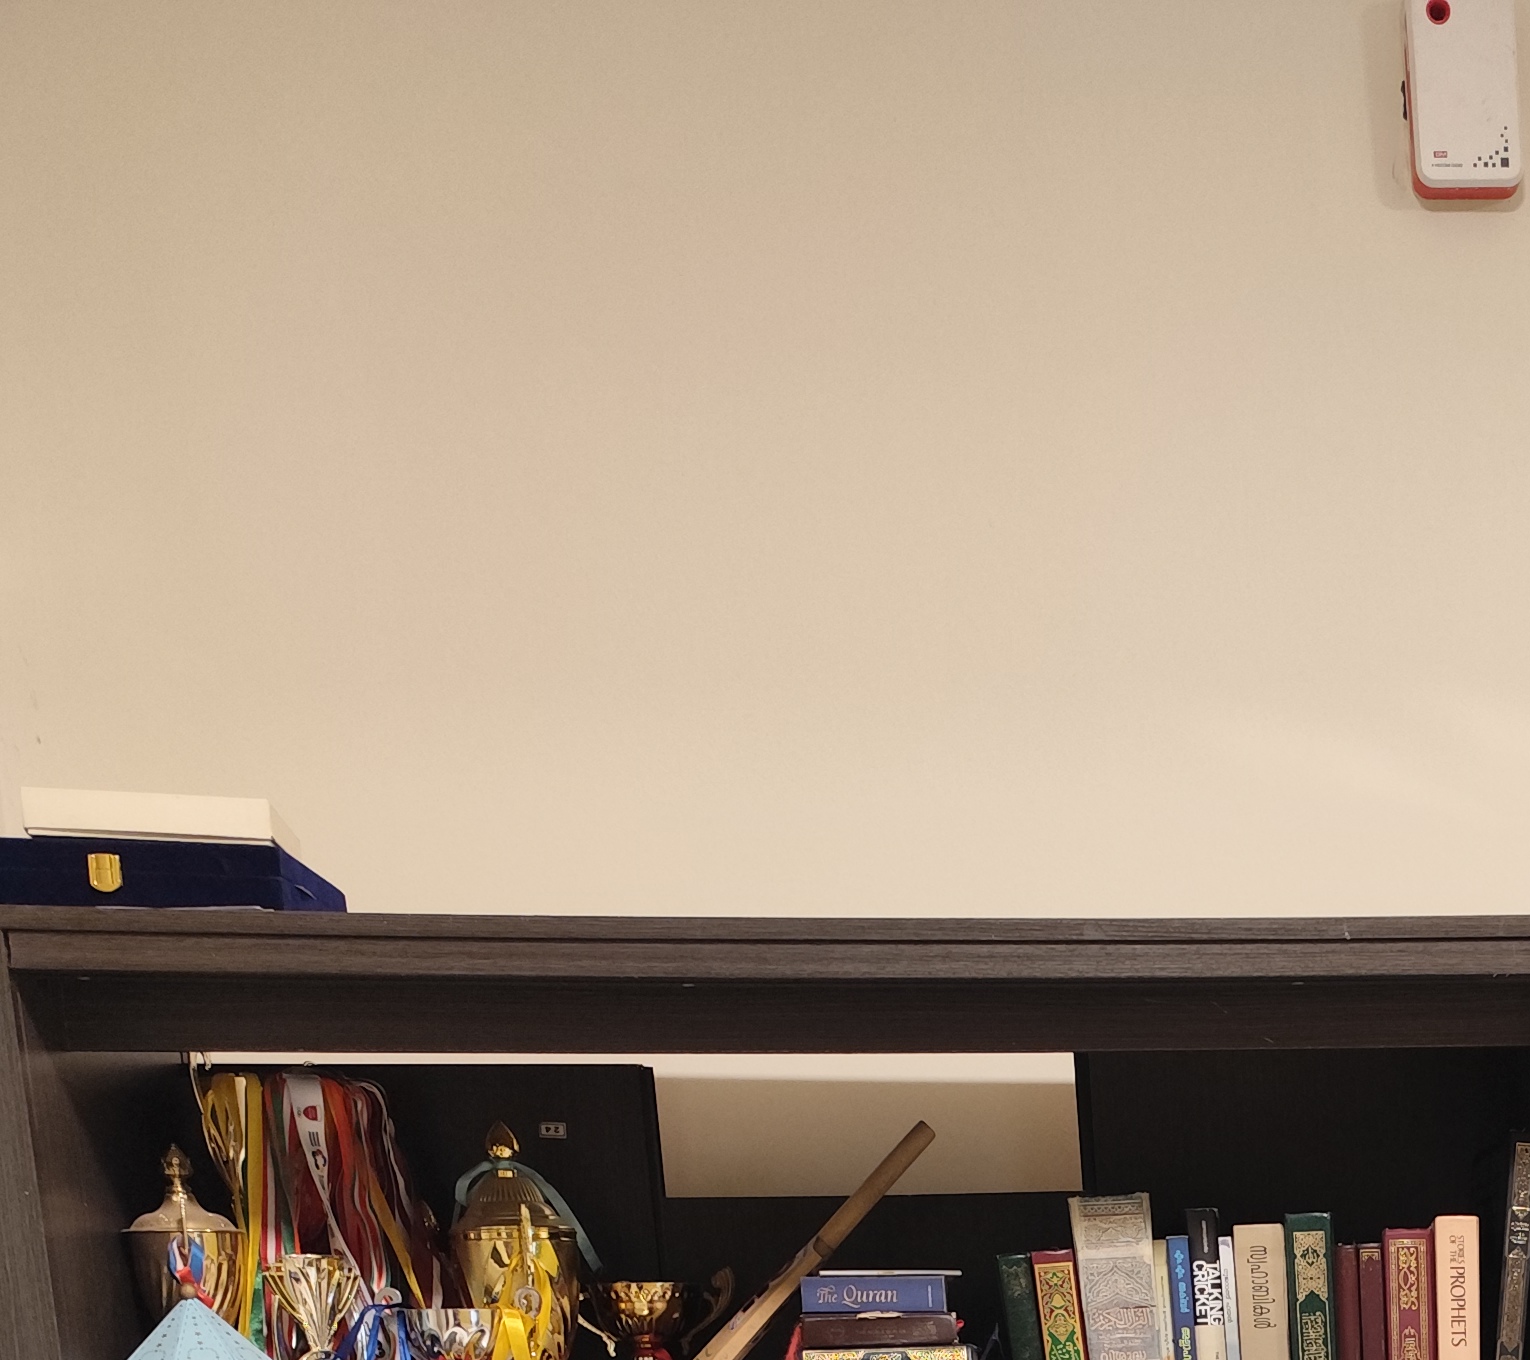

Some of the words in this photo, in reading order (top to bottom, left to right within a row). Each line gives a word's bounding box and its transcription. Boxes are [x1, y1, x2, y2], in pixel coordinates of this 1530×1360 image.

[1449, 1235, 1457, 1248] OF
[1457, 1235, 1465, 1264] STORIES
[1450, 1250, 1458, 1264] THE
[817, 1285, 838, 1303] The
[842, 1285, 898, 1308] Quran
[1193, 1260, 1210, 1326] CRICKET
[1206, 1259, 1224, 1326] TALKING
[1449, 1266, 1467, 1348] PROPHETS
